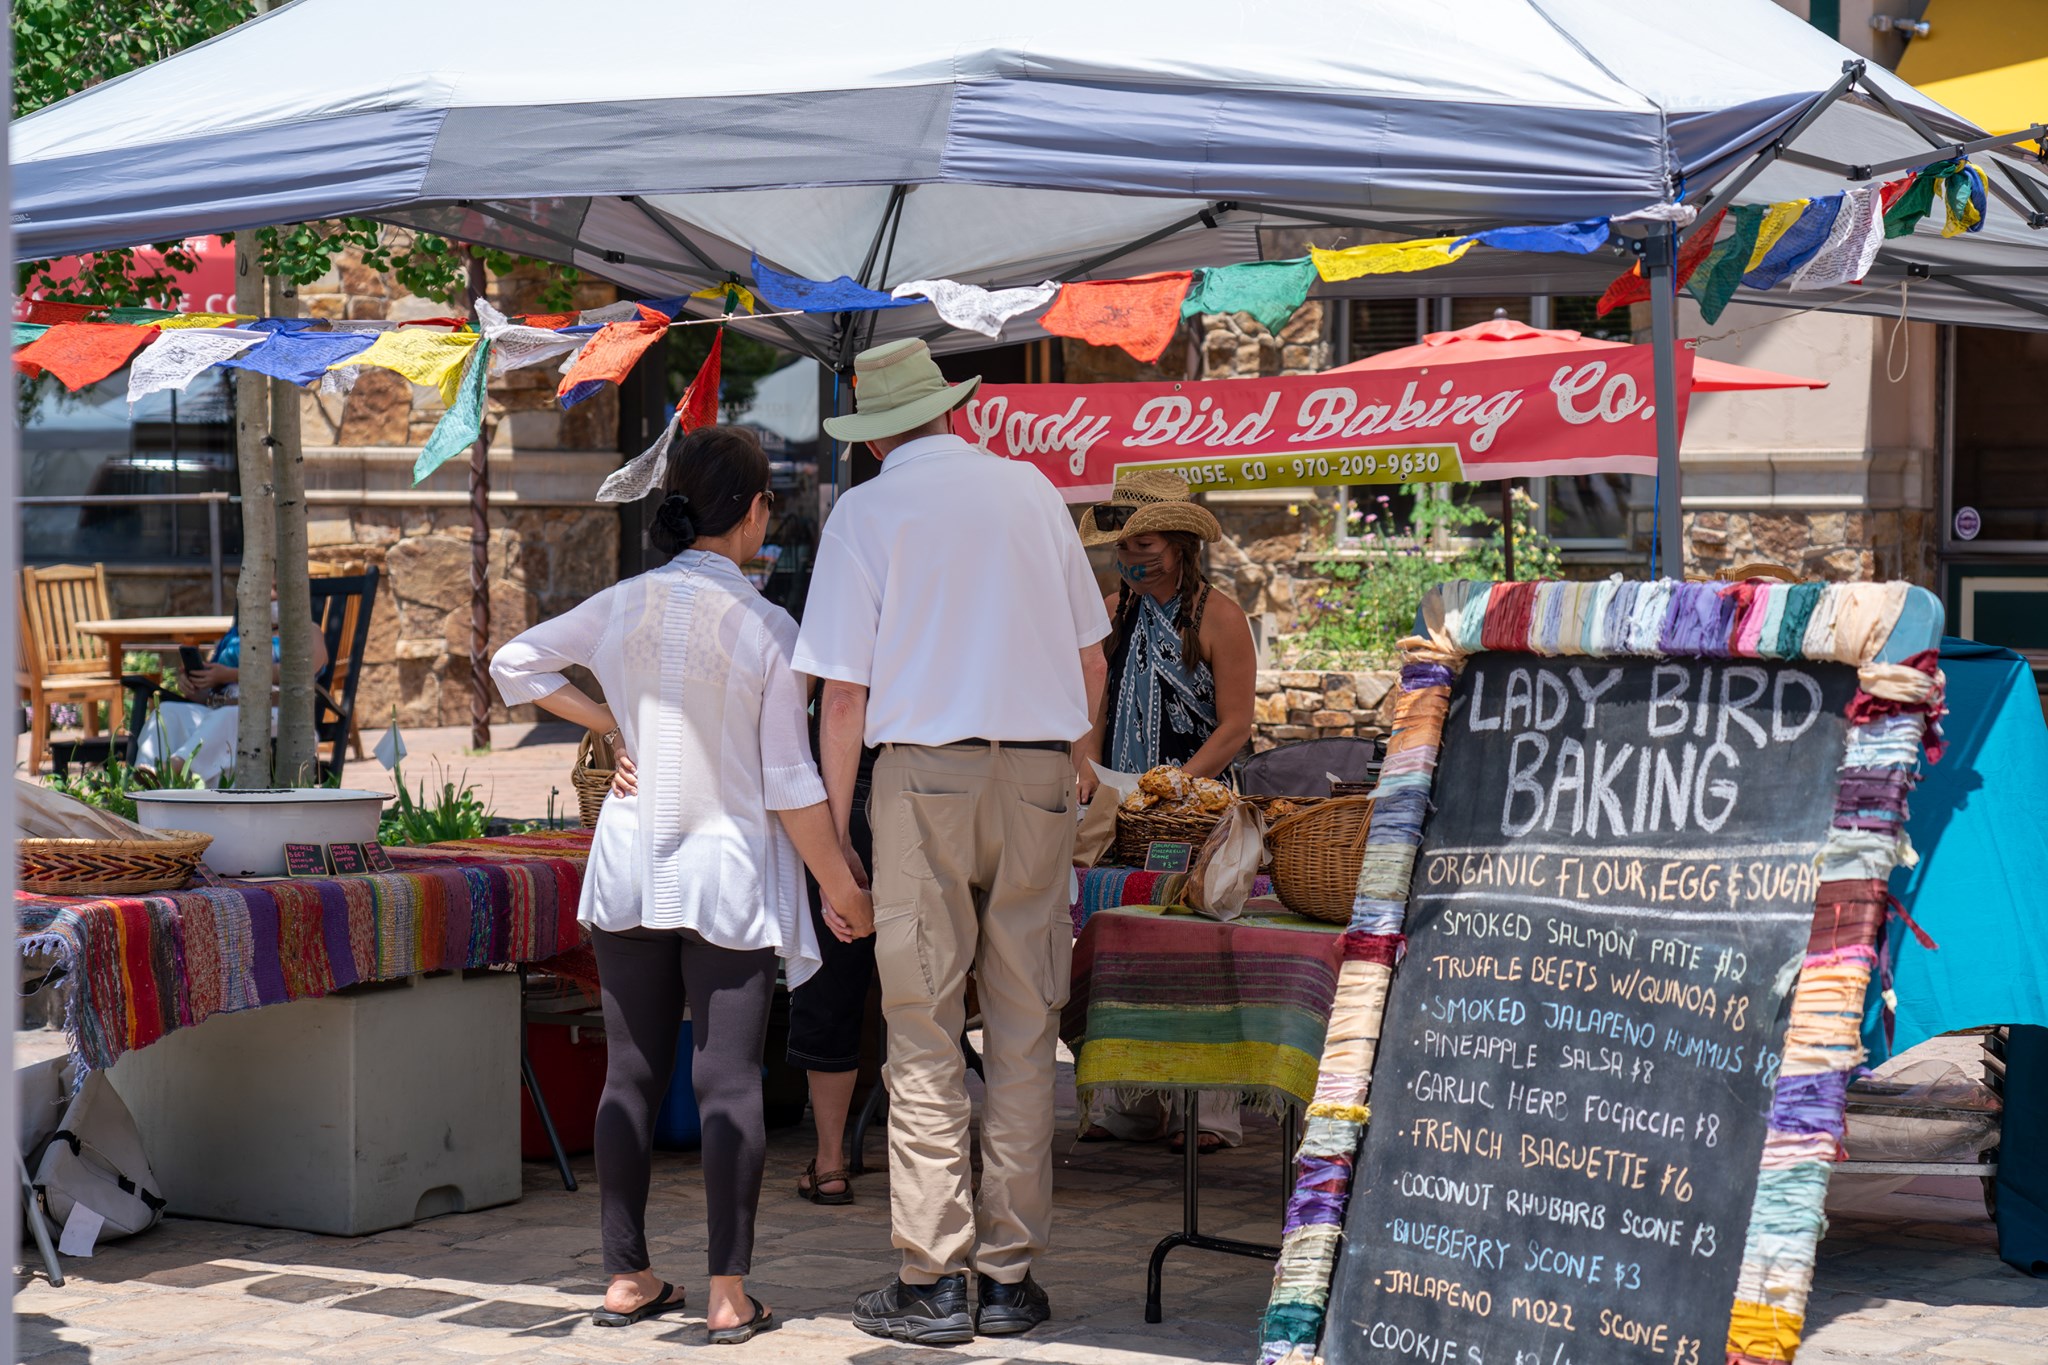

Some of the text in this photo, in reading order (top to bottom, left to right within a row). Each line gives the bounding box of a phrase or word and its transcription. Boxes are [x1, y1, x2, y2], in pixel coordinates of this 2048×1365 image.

[966, 360, 1656, 476] Lady Bird Baking Co.
[1241, 461, 1268, 480] CO
[1292, 452, 1441, 478] 970-209-9630
[1468, 664, 1823, 749] LADY BIRD
[1501, 731, 1740, 839] BAKING
[1427, 853, 1547, 887] ORGANIC
[1443, 909, 1531, 941] SMOKED
[1547, 917, 1638, 960] SALMON
[1651, 938, 1703, 971] PATE
[1432, 955, 1750, 1032] TRUFFLE BEETS W/QUINOA $8
[1424, 1029, 1656, 1085] PINEAPPLE SALSA $8
[1431, 995, 1782, 1088] SMOKED JALAPENO HUMMUS $8
[1414, 1070, 1721, 1148] GARLIC HERB FOCACCIA $8
[1411, 1118, 1694, 1203] FRENCH BAGUETTE $6
[1401, 1171, 1718, 1258] COCONUT RHUBARB SCONE $3
[1524, 1239, 1605, 1285] SCONE
[1613, 1261, 1642, 1291] $3
[1383, 1269, 1492, 1317] JALAPENO
[1599, 1308, 1669, 1354] SCONE
[1673, 1334, 1701, 1365] $3
